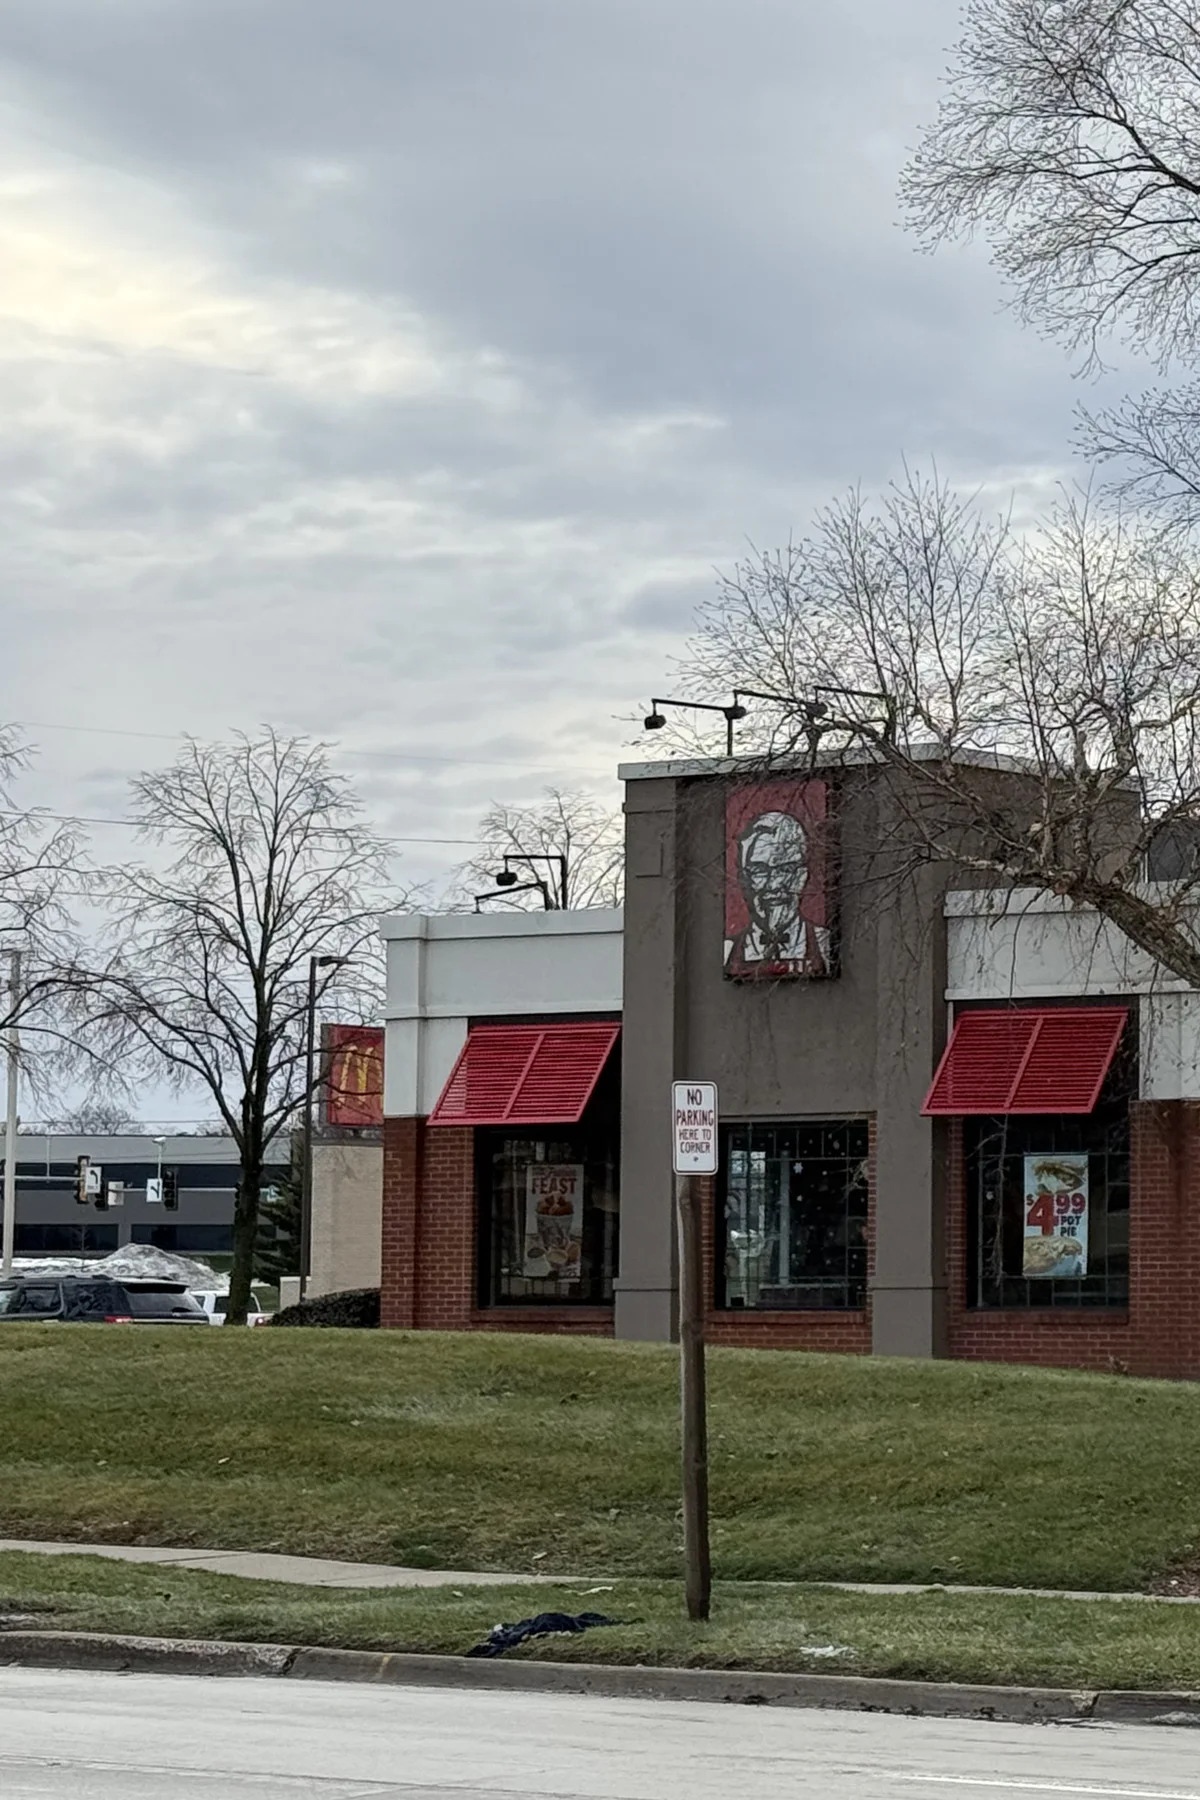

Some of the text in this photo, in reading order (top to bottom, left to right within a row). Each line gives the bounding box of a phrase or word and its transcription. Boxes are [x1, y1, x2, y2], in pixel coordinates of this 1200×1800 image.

[686, 1088, 703, 1106] NO
[676, 1109, 714, 1127] PARKING
[679, 1128, 712, 1141] HERE TO
[680, 1141, 711, 1154] CORNER
[532, 1177, 578, 1195] FEAST
[1060, 1215, 1082, 1226] POT
[1060, 1226, 1077, 1237] PIE
